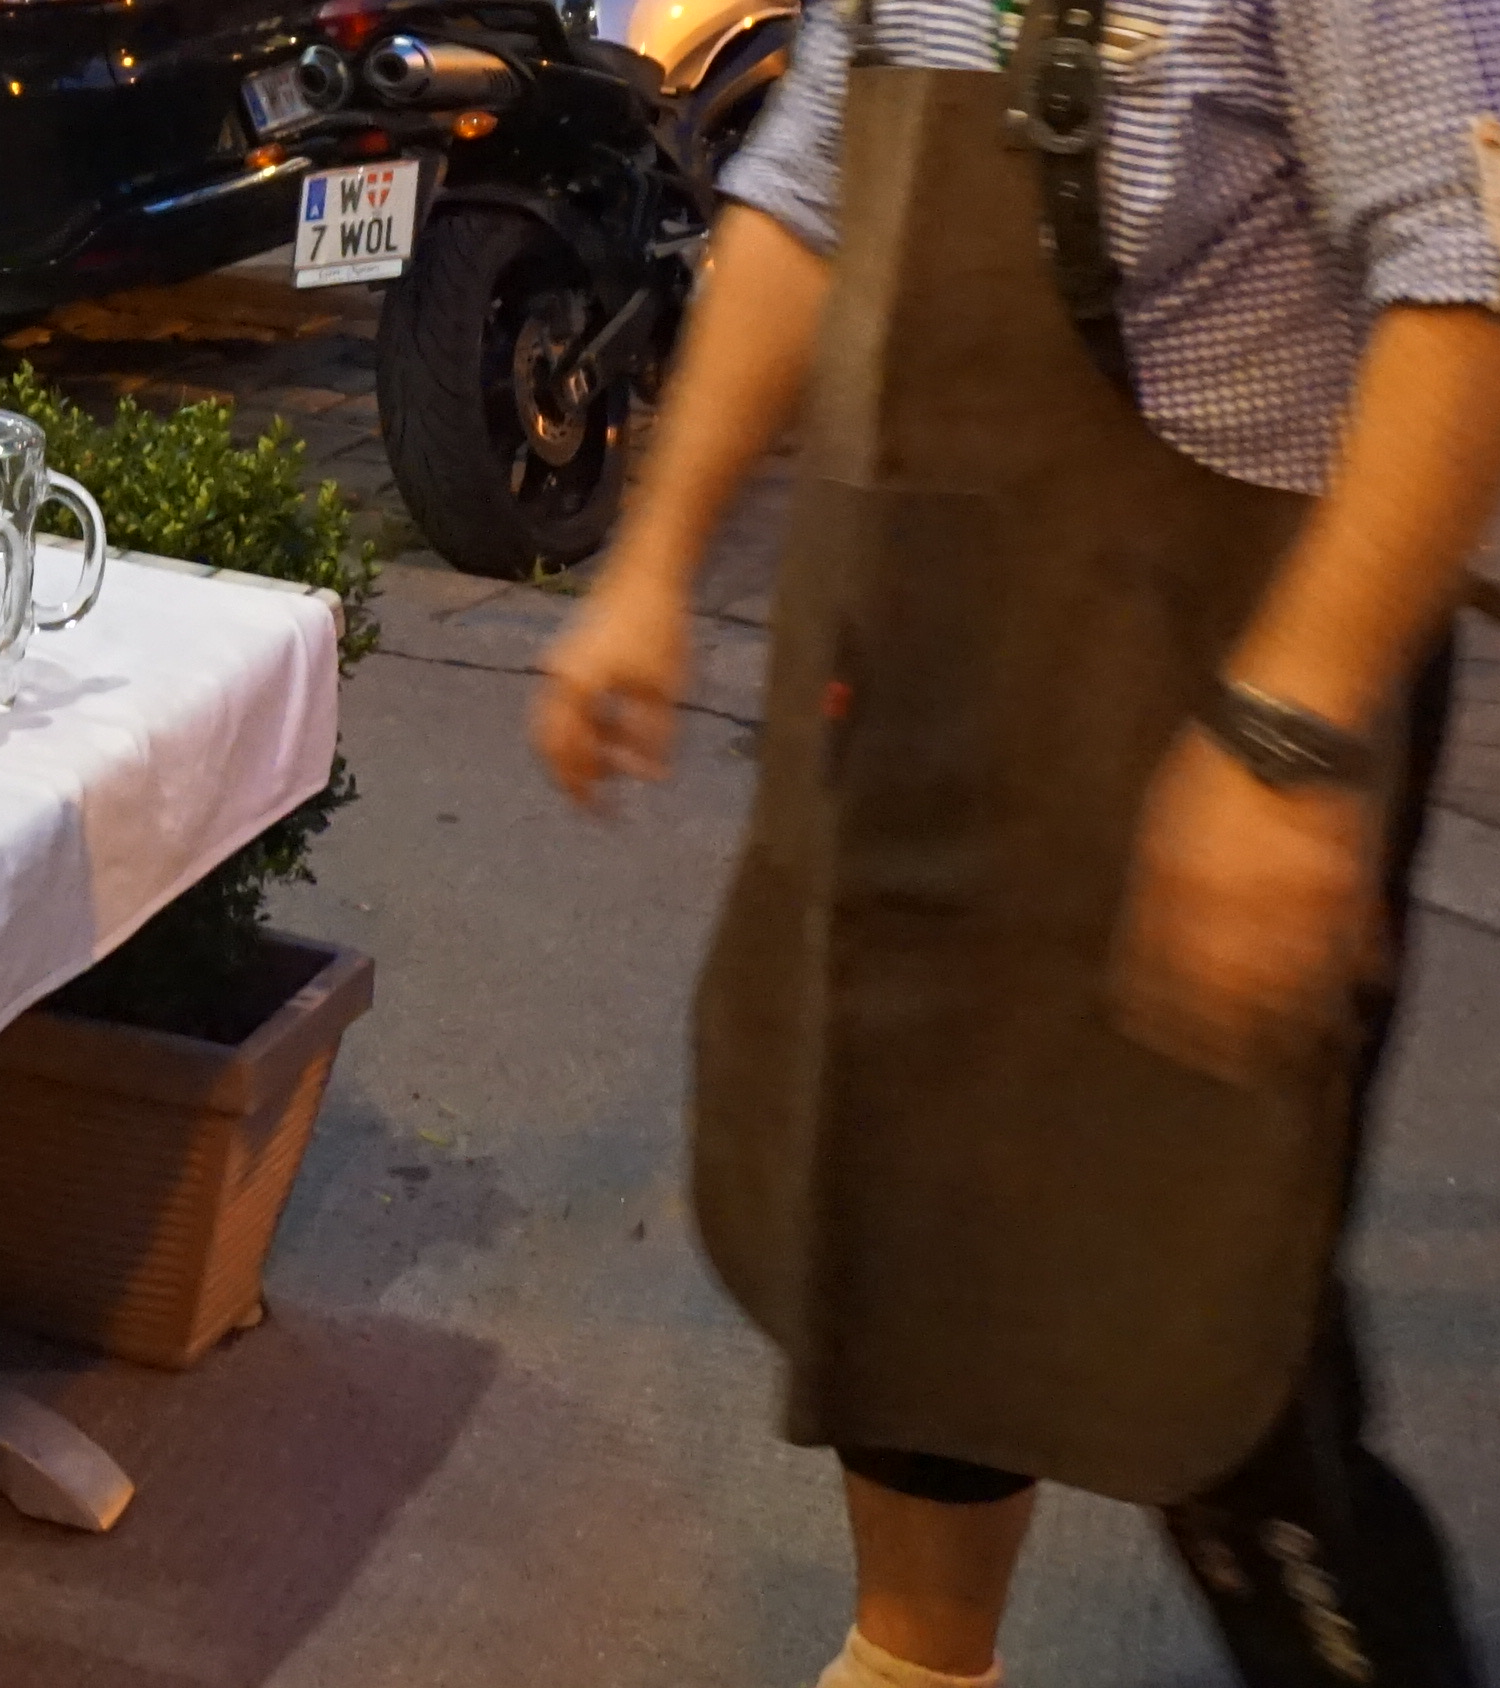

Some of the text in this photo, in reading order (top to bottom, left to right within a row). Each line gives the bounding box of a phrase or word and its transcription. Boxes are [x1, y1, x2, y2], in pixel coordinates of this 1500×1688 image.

[340, 175, 364, 214] W
[310, 216, 398, 262] 7 WOL
